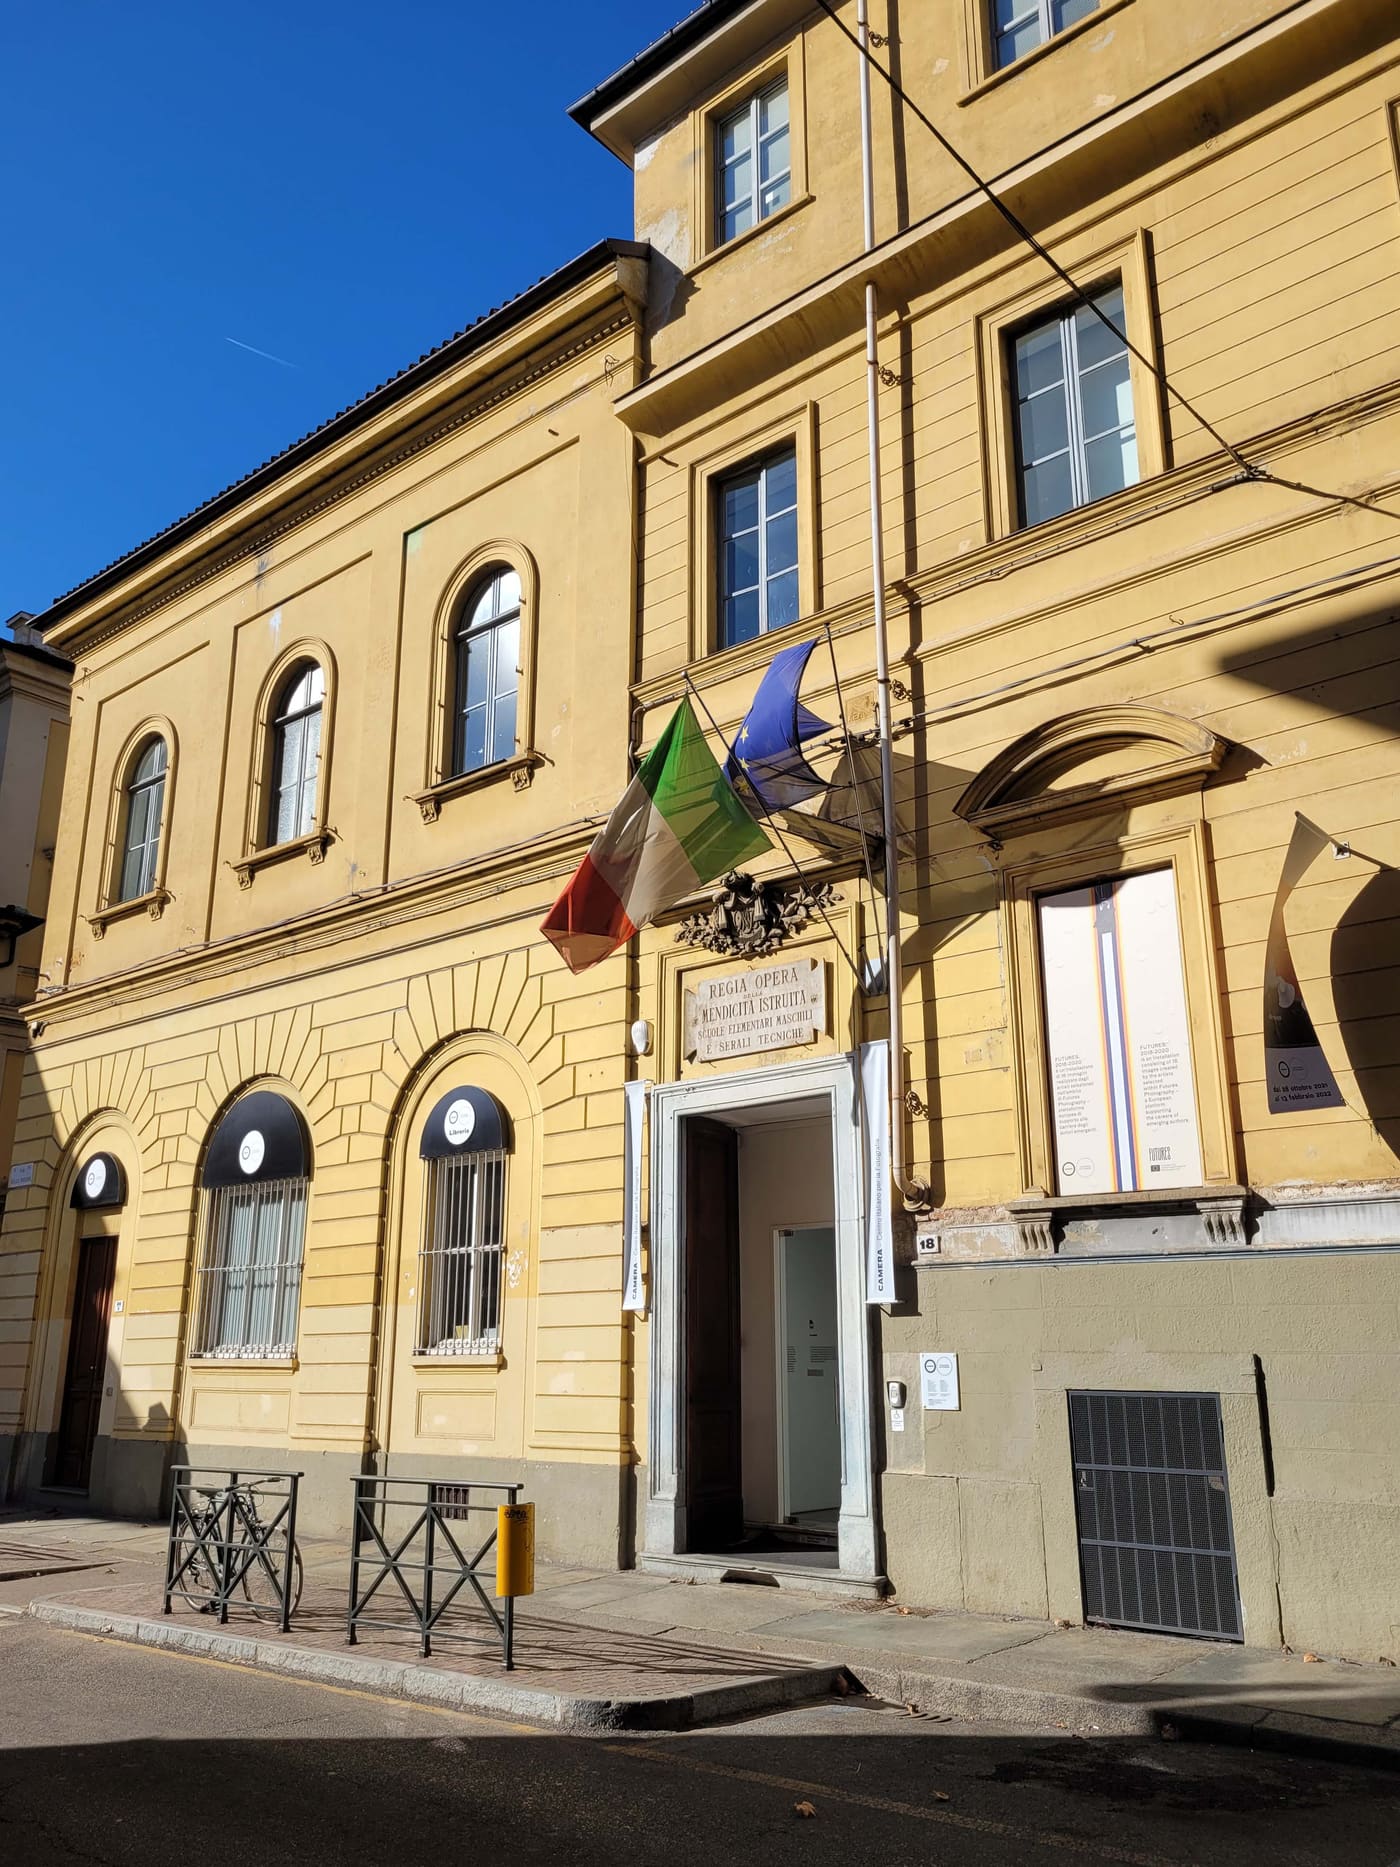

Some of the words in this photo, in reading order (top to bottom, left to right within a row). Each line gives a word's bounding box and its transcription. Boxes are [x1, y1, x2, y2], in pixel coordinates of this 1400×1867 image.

[710, 979, 747, 999] REGIA
[756, 968, 798, 989] OPERA
[698, 1026, 724, 1040] SCUOLE
[728, 1017, 772, 1034] ELEMENTARI
[776, 1010, 812, 1026] MASCHILI
[707, 1044, 712, 1054] E
[720, 1038, 751, 1051] SERALI
[759, 1028, 803, 1045] TECNICHE
[1149, 1146, 1171, 1161] FUTURES
[920, 1238, 935, 1249] 18
